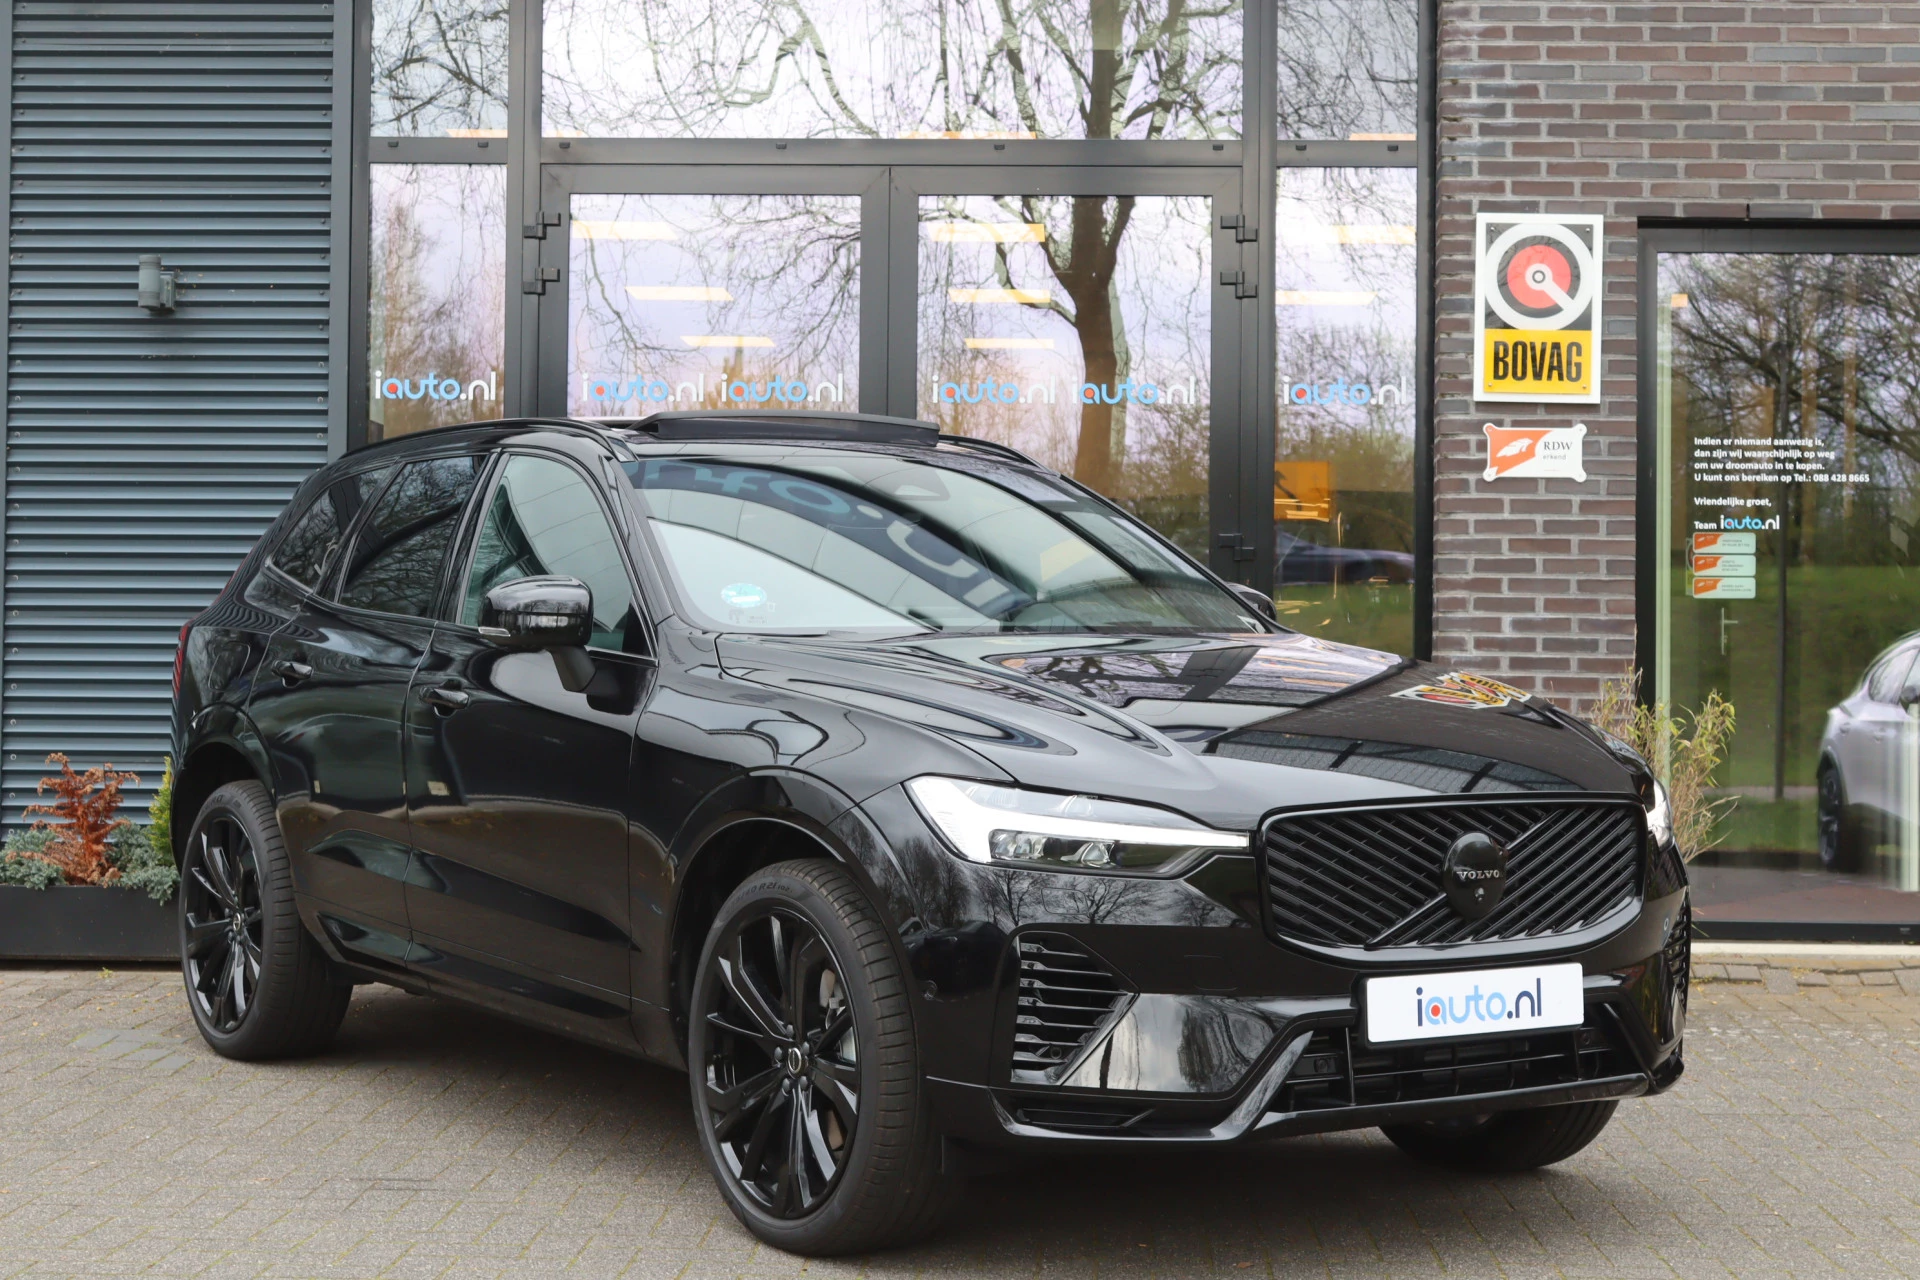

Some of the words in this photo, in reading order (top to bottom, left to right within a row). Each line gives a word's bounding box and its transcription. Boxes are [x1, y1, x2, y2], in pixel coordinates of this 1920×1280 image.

[1493, 341, 1583, 382] BOVAG
[374, 370, 496, 401] iauto.nl
[582, 372, 704, 403] iauto.nl
[720, 372, 843, 403] iauto.nl
[931, 374, 1056, 405] iauto.nl
[1071, 374, 1195, 405] iauto.nl
[1283, 375, 1407, 405] iauto.nl
[1544, 441, 1572, 450] RDW
[1694, 437, 1721, 445] Indien
[1734, 437, 1771, 445] niemand
[1773, 437, 1813, 447] aanwezig
[1815, 437, 1824, 447] is,
[1694, 449, 1710, 457] dan
[1712, 449, 1727, 459] zijn
[1729, 449, 1742, 459] wij
[1744, 449, 1802, 459] waarschijnlijk
[1804, 451, 1815, 459] op
[1817, 451, 1835, 460] weg
[1725, 461, 1773, 469] droomauto
[1775, 461, 1783, 469] in
[1785, 462, 1794, 470] te
[1796, 461, 1825, 471] kopen.
[1694, 473, 1701, 481] U
[1703, 473, 1722, 481] kunt
[1741, 473, 1778, 481] bereiken
[1780, 475, 1792, 483] op
[1794, 473, 1811, 482] Tel.:
[1813, 474, 1829, 482] 088
[1831, 474, 1847, 482] 428
[1848, 474, 1870, 482] 8665
[1694, 497, 1744, 507] Vriendelijke
[1746, 498, 1772, 507] groet,
[1694, 521, 1717, 529] Team
[1720, 514, 1780, 530] iauto.nl
[1456, 870, 1500, 880] VOLVO
[1416, 977, 1542, 1027] iauto.nl
